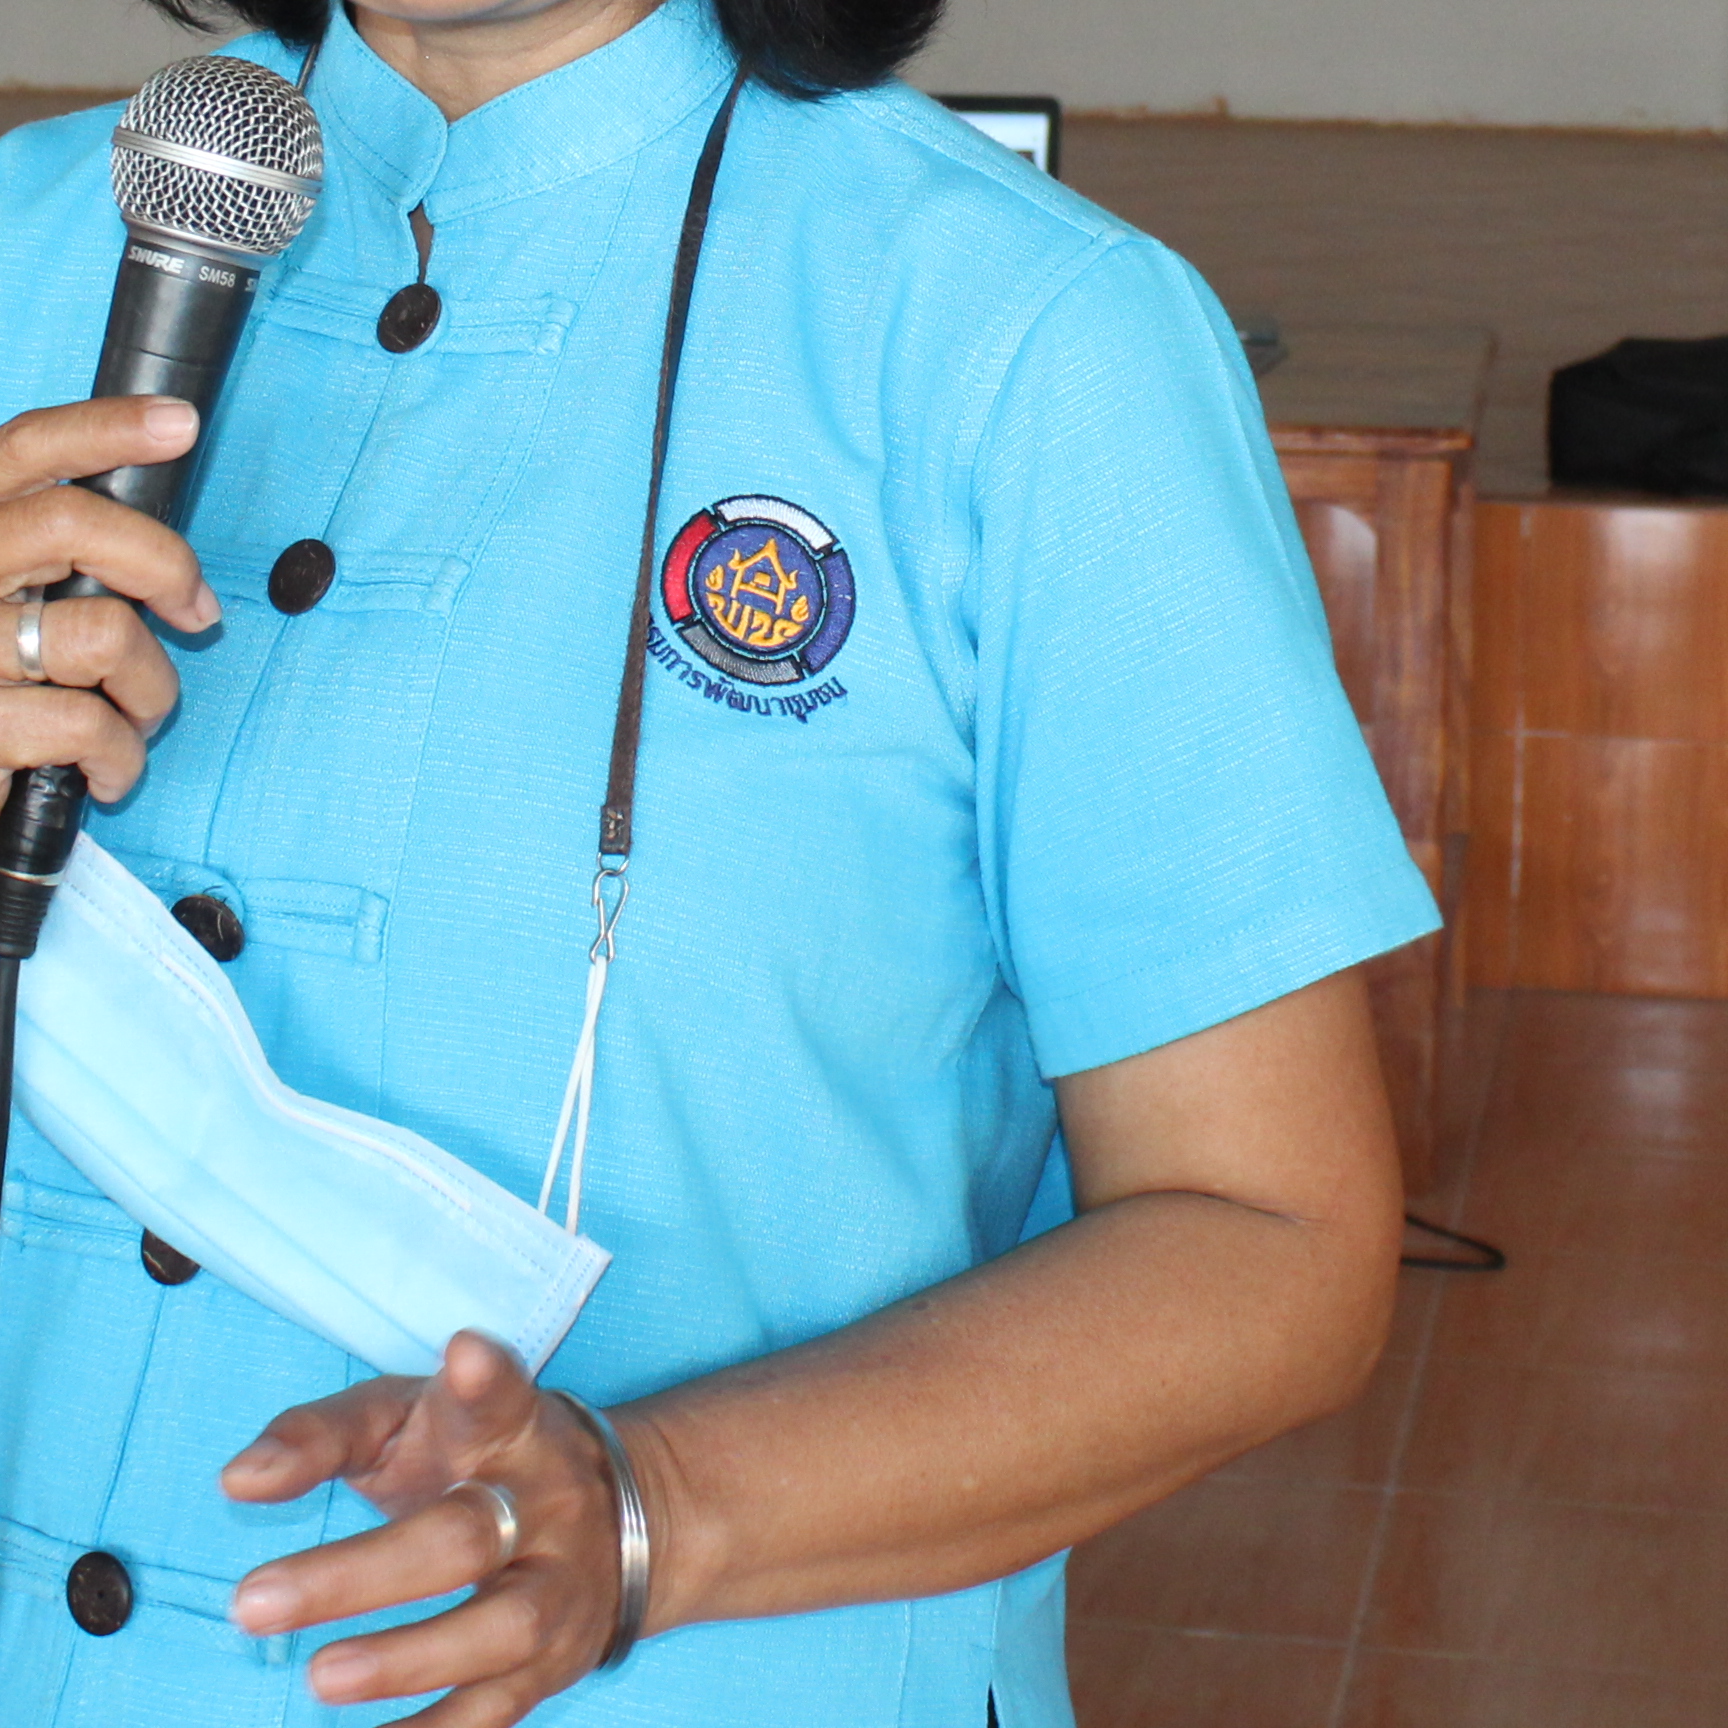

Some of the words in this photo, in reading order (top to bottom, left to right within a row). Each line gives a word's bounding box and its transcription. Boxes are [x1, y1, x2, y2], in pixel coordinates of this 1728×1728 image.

[127, 244, 185, 274] SHURE
[198, 265, 236, 287] SM58
[647, 612, 849, 724] รมการพัฒนาชุมชน
